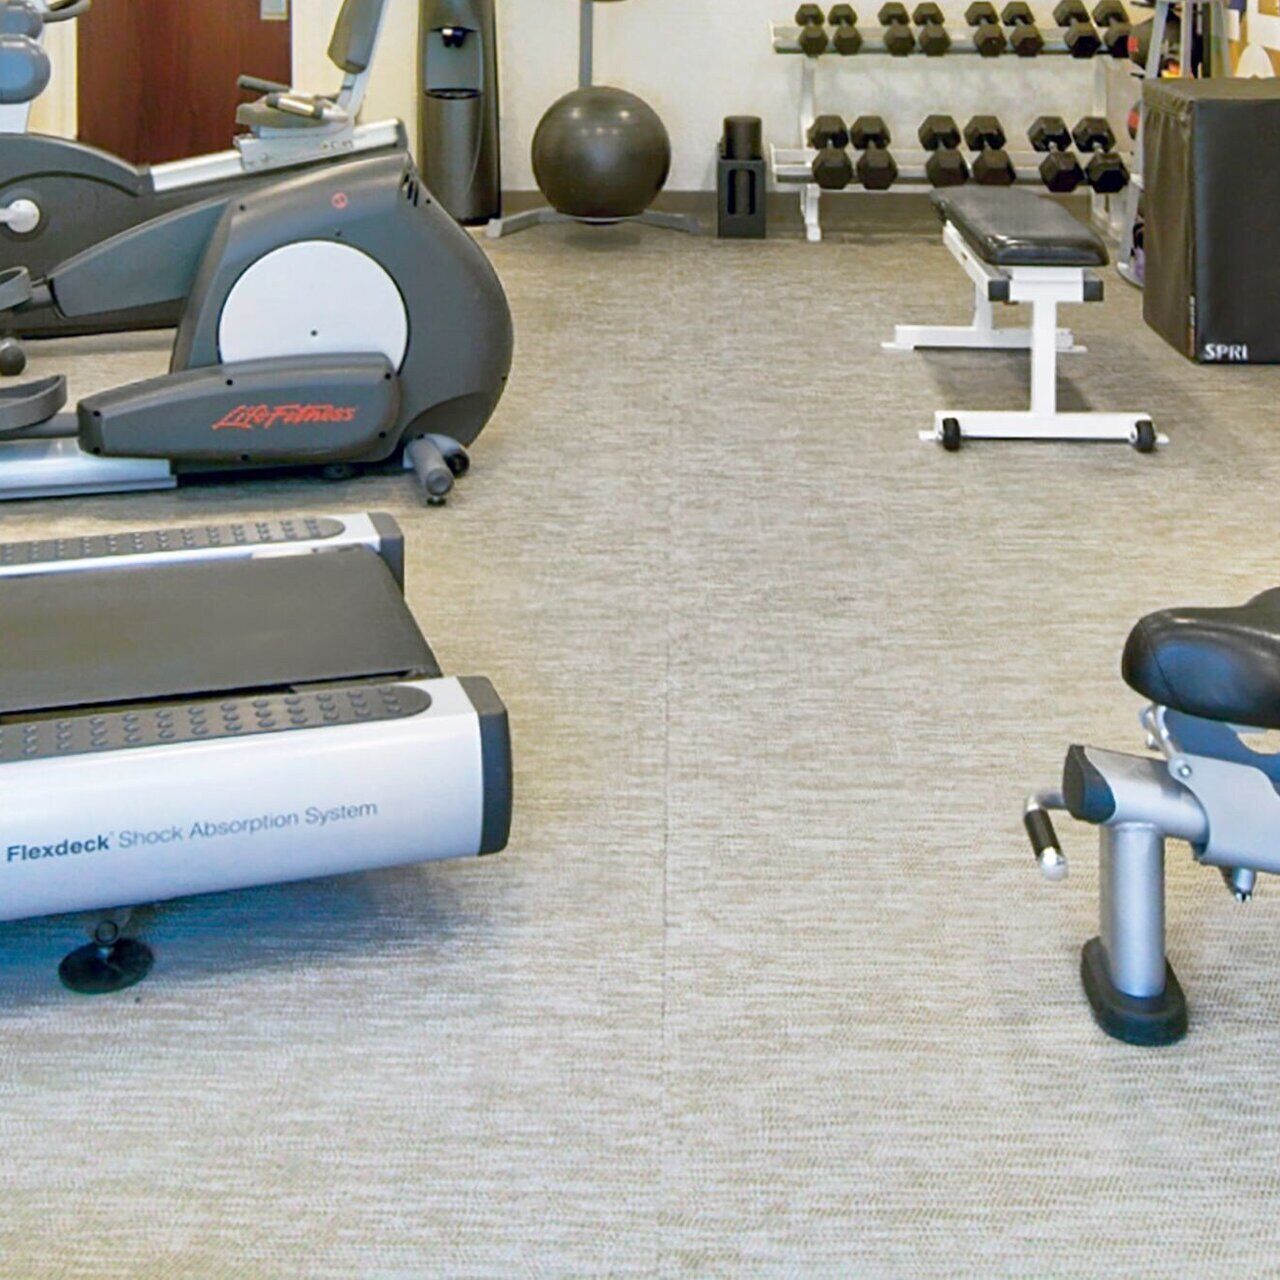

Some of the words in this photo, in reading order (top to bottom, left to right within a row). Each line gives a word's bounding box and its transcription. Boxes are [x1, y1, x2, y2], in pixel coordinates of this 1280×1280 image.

[1204, 343, 1248, 360] SPRI
[6, 834, 110, 863] Flexdeck
[118, 824, 183, 849] Shock
[189, 810, 300, 840] Absorption
[305, 800, 379, 826] System
